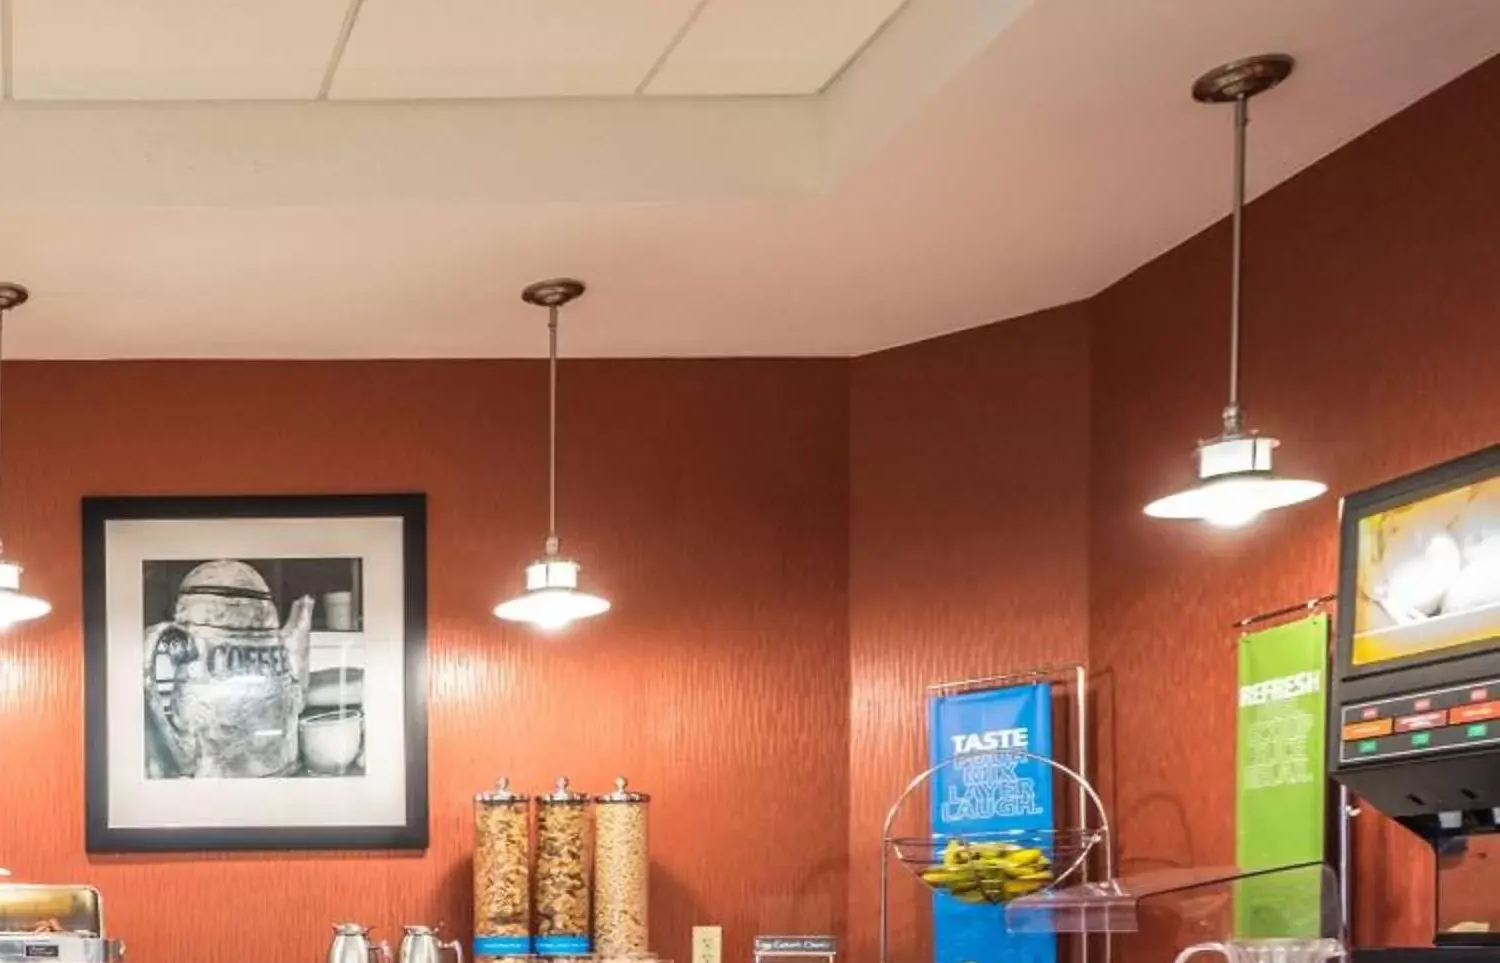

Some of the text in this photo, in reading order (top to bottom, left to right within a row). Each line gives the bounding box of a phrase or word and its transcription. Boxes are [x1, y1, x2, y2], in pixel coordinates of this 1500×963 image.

[207, 645, 290, 677] COFFEE
[951, 728, 1029, 755] TASTE
[948, 777, 1036, 806] LAYER
